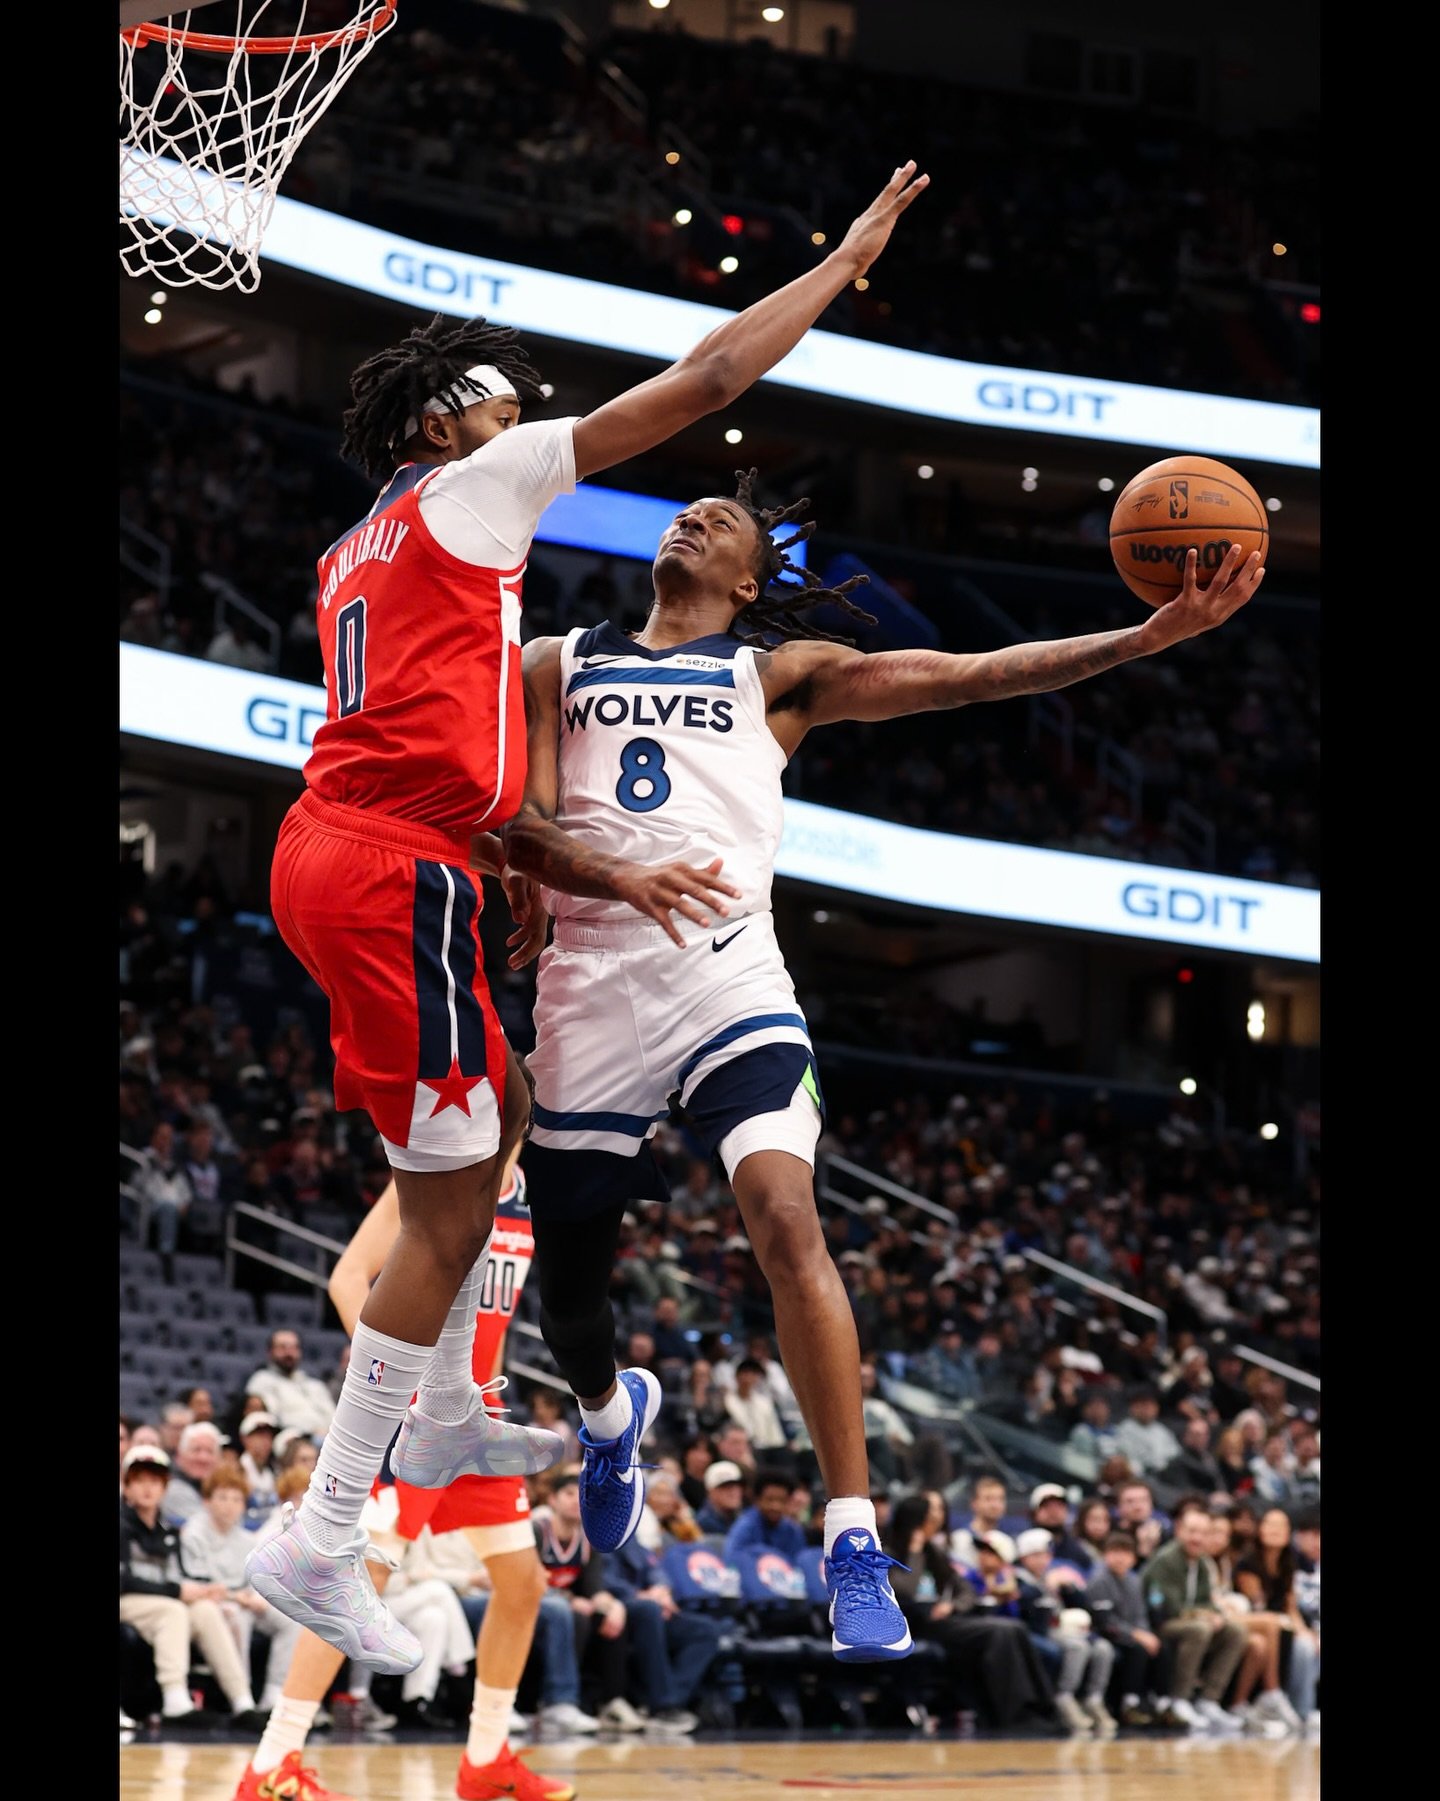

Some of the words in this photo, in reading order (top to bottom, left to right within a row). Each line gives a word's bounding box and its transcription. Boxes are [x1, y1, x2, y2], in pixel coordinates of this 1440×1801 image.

[383, 251, 513, 304] GDIT
[978, 380, 1116, 420] GDIT
[322, 517, 410, 610] COULIBALY
[335, 594, 368, 719] 0
[685, 658, 726, 669] sezzle
[564, 693, 734, 735] WOLVES
[615, 736, 672, 813] 8
[1123, 883, 1261, 930] GDIT
